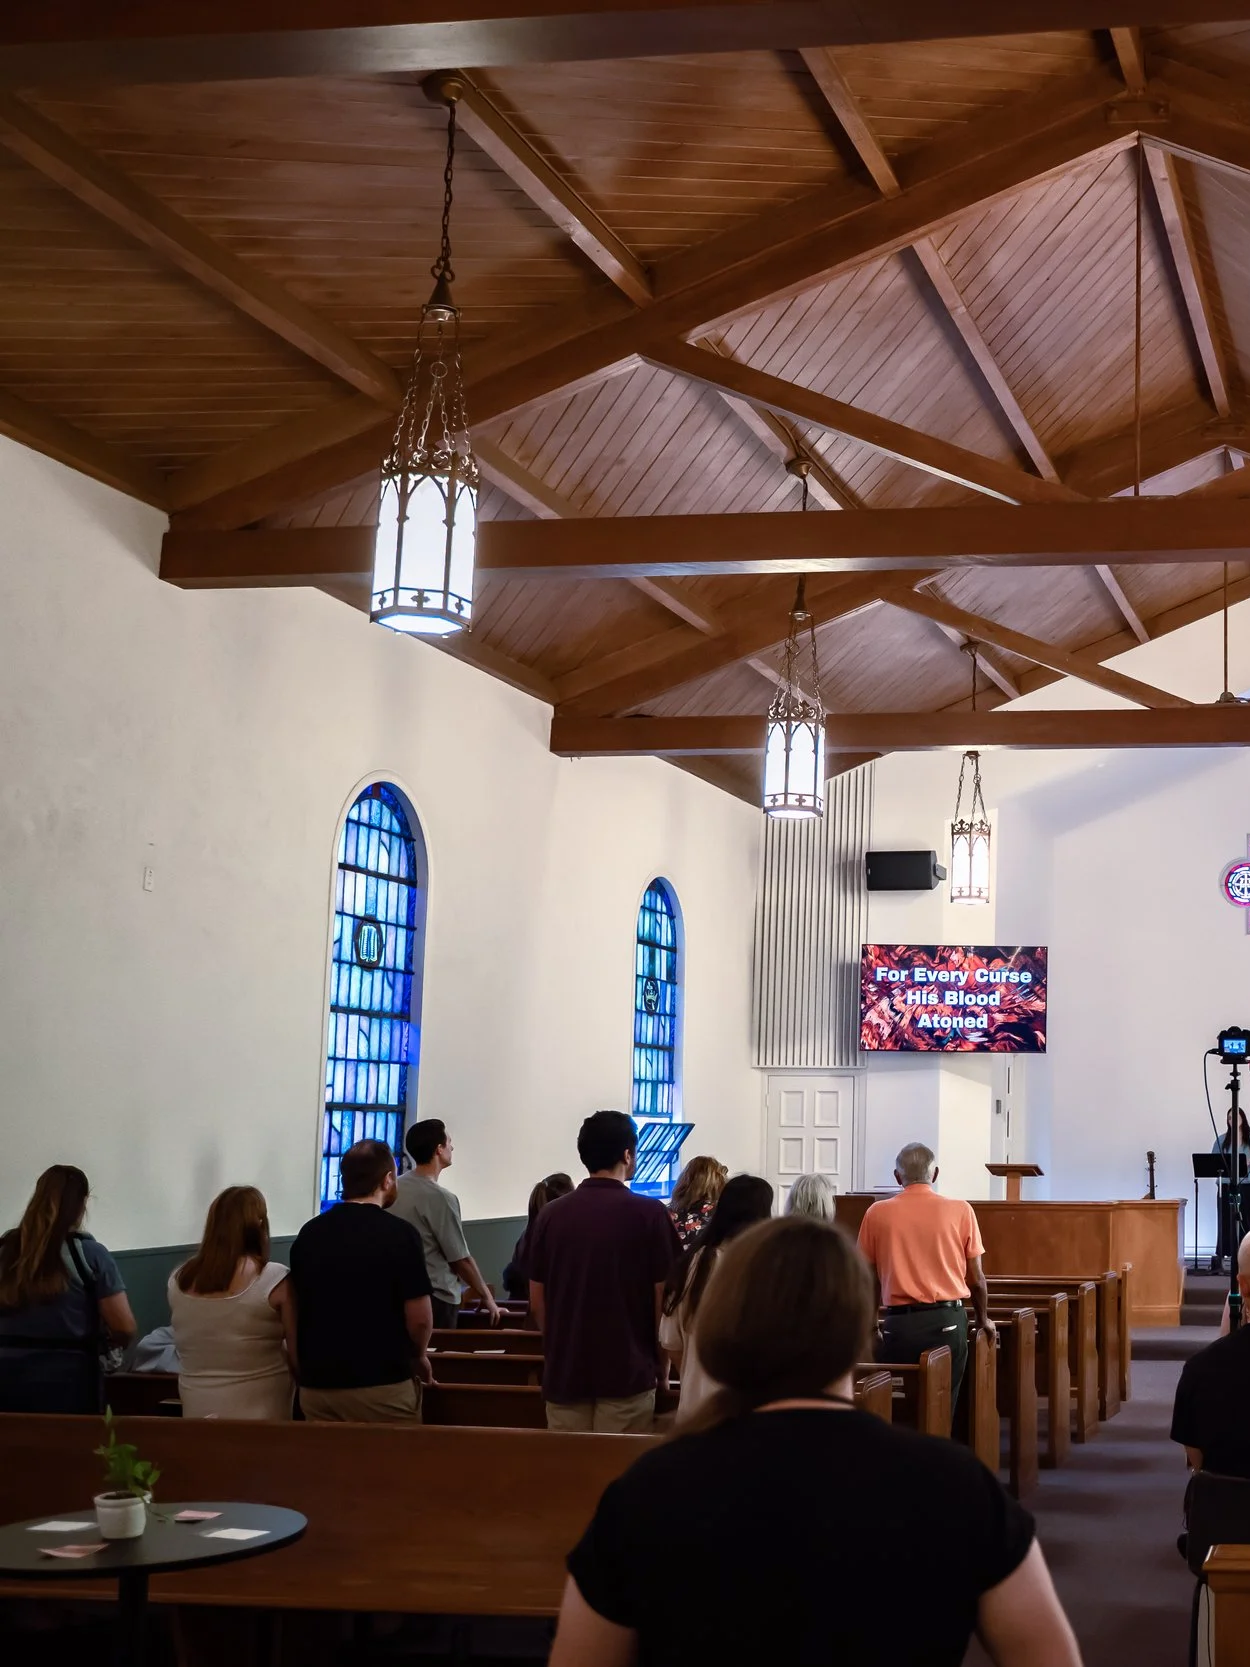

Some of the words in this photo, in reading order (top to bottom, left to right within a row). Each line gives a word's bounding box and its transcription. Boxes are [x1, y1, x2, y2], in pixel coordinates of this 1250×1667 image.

[875, 967, 908, 982] For
[914, 968, 968, 984] Every
[975, 969, 1032, 983] Curse
[907, 991, 939, 1005] His
[945, 991, 1000, 1006] Blood
[918, 1014, 988, 1028] Atoned
